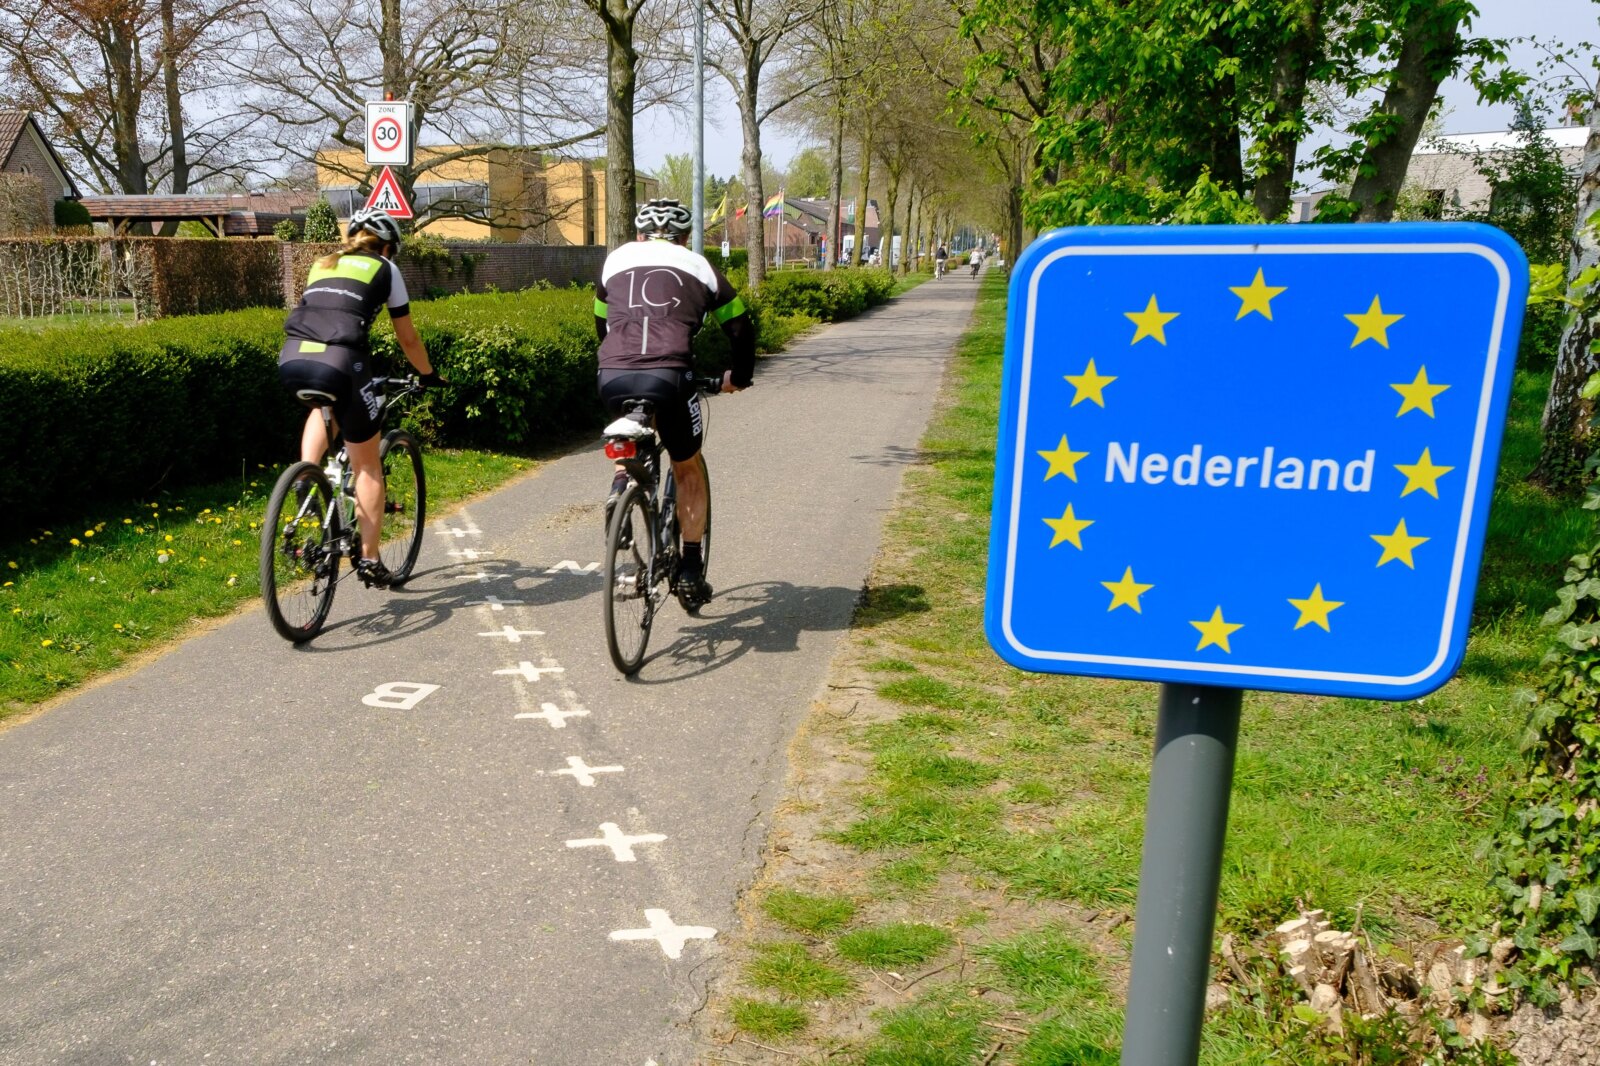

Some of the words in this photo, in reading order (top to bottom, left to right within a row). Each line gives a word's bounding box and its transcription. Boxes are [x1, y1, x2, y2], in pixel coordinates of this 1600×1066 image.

[377, 126, 398, 141] 30
[360, 381, 379, 421] Lema
[687, 392, 702, 437] Lema
[1104, 441, 1376, 493] Nederland
[361, 681, 442, 710] B
